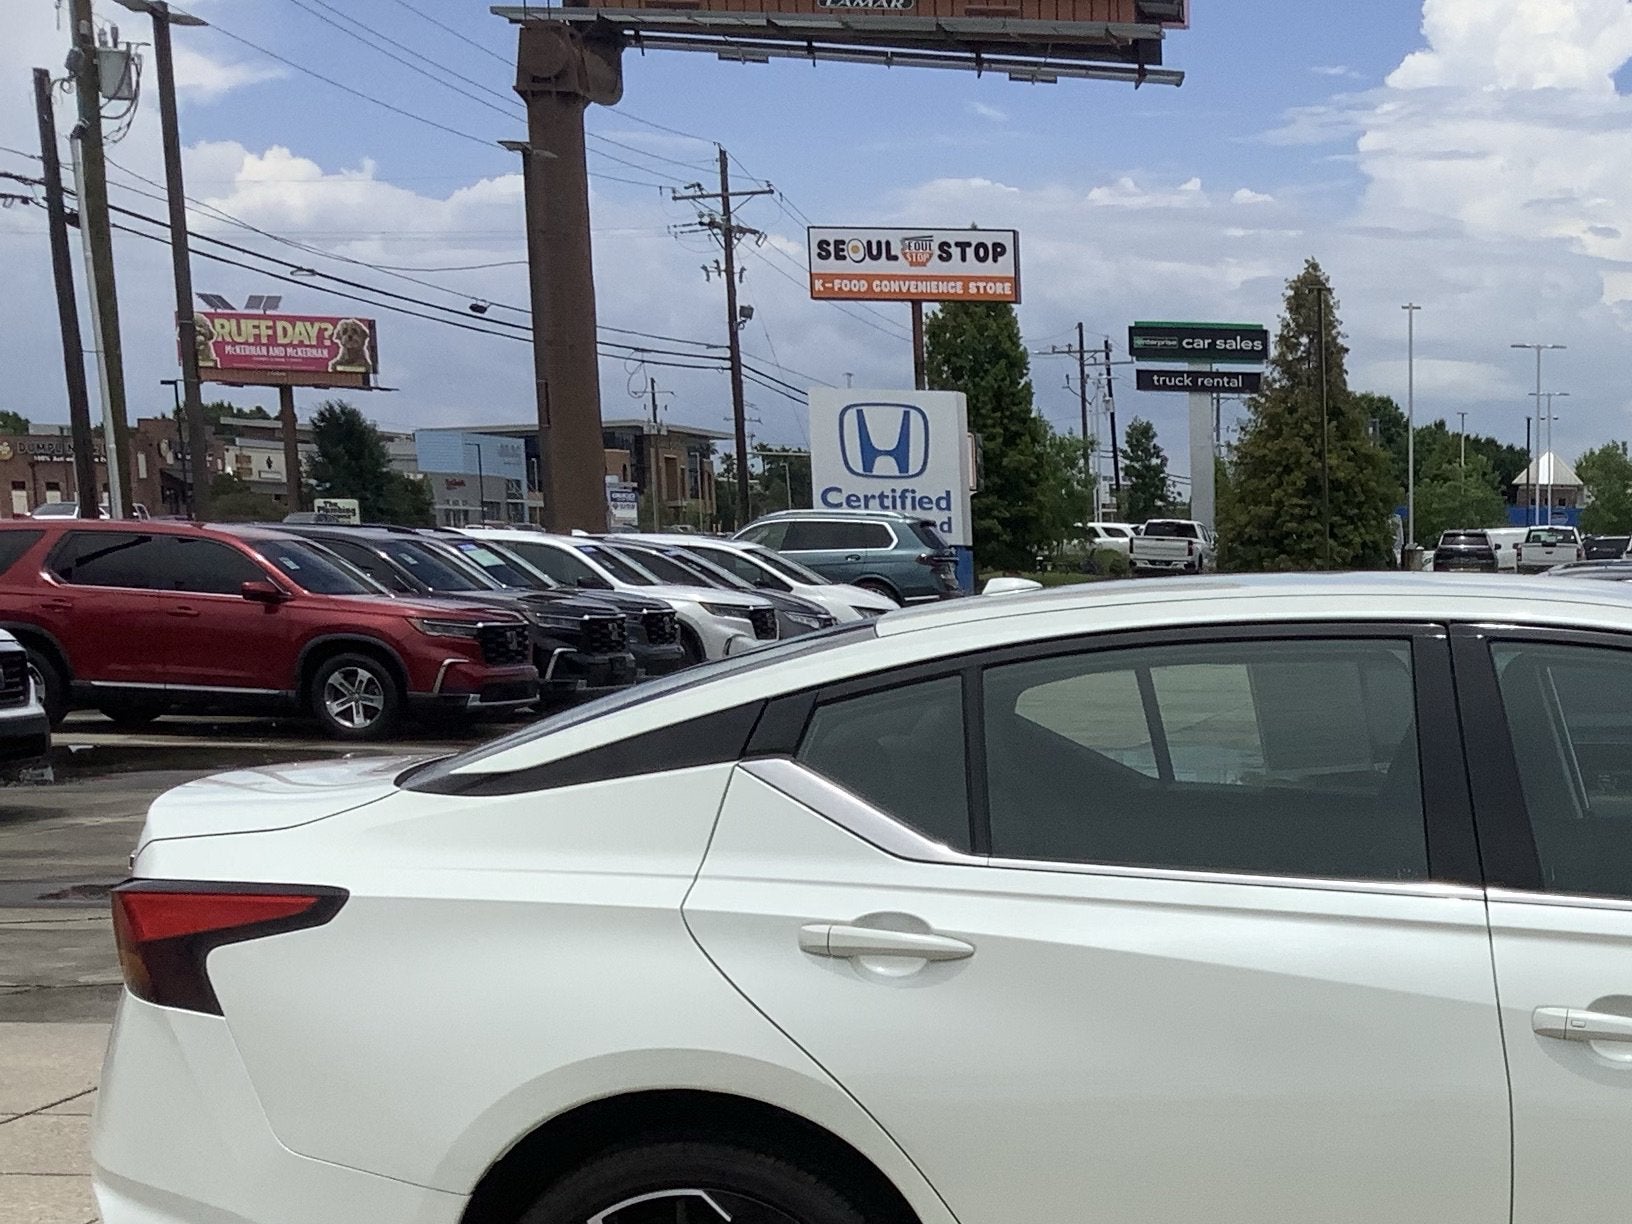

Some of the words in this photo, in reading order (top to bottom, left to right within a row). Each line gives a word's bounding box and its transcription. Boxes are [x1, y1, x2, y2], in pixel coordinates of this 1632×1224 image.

[816, 238, 899, 263] SEOUL
[937, 241, 1007, 263] STOP
[814, 279, 868, 292] K-FOOD
[872, 279, 964, 294] CONVENIENCE
[968, 282, 1012, 294] STORE
[213, 318, 273, 343] RUFF
[276, 320, 334, 346] DAY?
[1182, 338, 1212, 349] car
[1215, 336, 1263, 351] sales
[268, 346, 285, 357] AND
[1152, 373, 1193, 386] truck
[1197, 375, 1243, 387] rental
[820, 486, 952, 511] Certified
